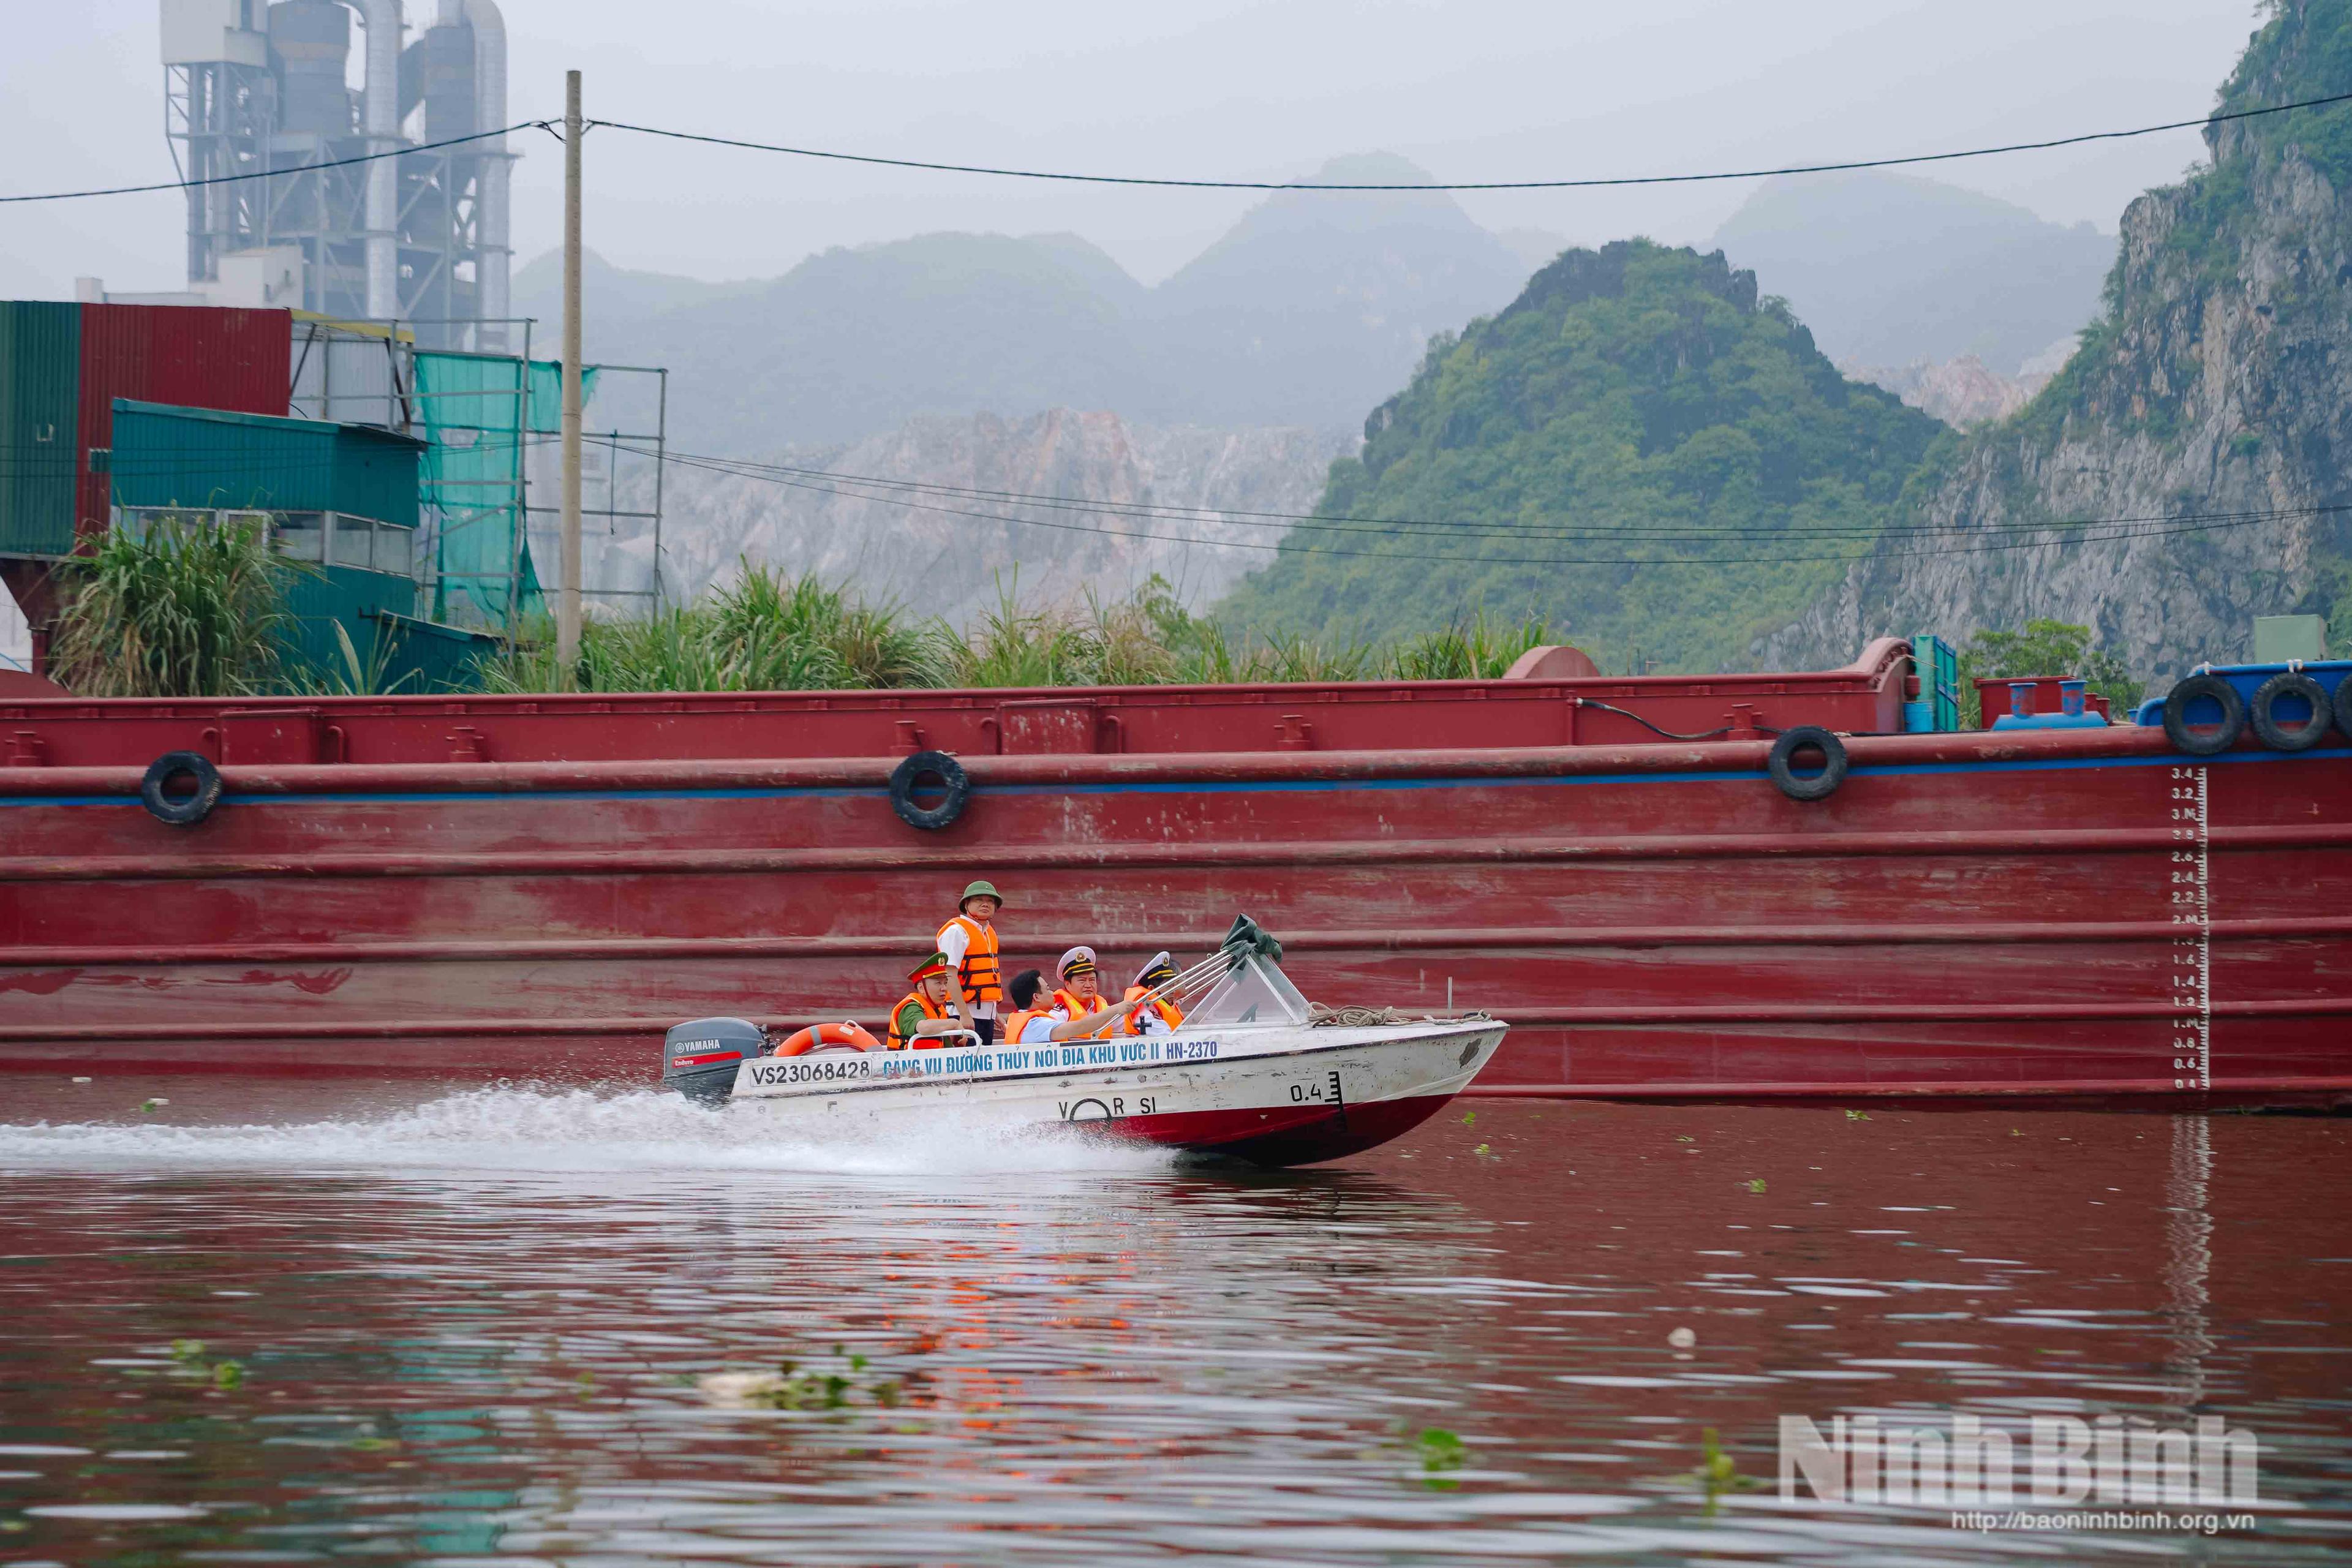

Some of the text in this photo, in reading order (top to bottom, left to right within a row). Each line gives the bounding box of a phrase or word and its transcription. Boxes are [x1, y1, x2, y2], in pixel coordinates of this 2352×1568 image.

[2171, 767, 2193, 779] 3.4
[2172, 788, 2193, 799] 3.2
[2172, 829, 2194, 840] 2.8
[2171, 851, 2193, 862] 2.6
[2172, 872, 2194, 883] 2.4
[2172, 891, 2194, 903] 2.2
[2172, 914, 2198, 924] 2.M
[2173, 954, 2195, 965] 1.6
[2174, 976, 2195, 987] 1.4
[2174, 997, 2195, 1006] 1.2
[2174, 1018, 2198, 1028] 1.M
[684, 1039, 720, 1052] YAMAHA
[2174, 1038, 2195, 1048] 0.8
[946, 1050, 992, 1073] ĐƯỜNG
[997, 1046, 1030, 1070] THỦY
[1089, 1046, 1116, 1064] KHU
[1150, 1042, 1159, 1060] II
[1166, 1041, 1218, 1059] HN-2370
[2174, 1058, 2195, 1069] 0.6
[752, 1061, 870, 1085] VS23068428
[1290, 1083, 1321, 1102] 0.4
[1140, 1096, 1156, 1114] SI
